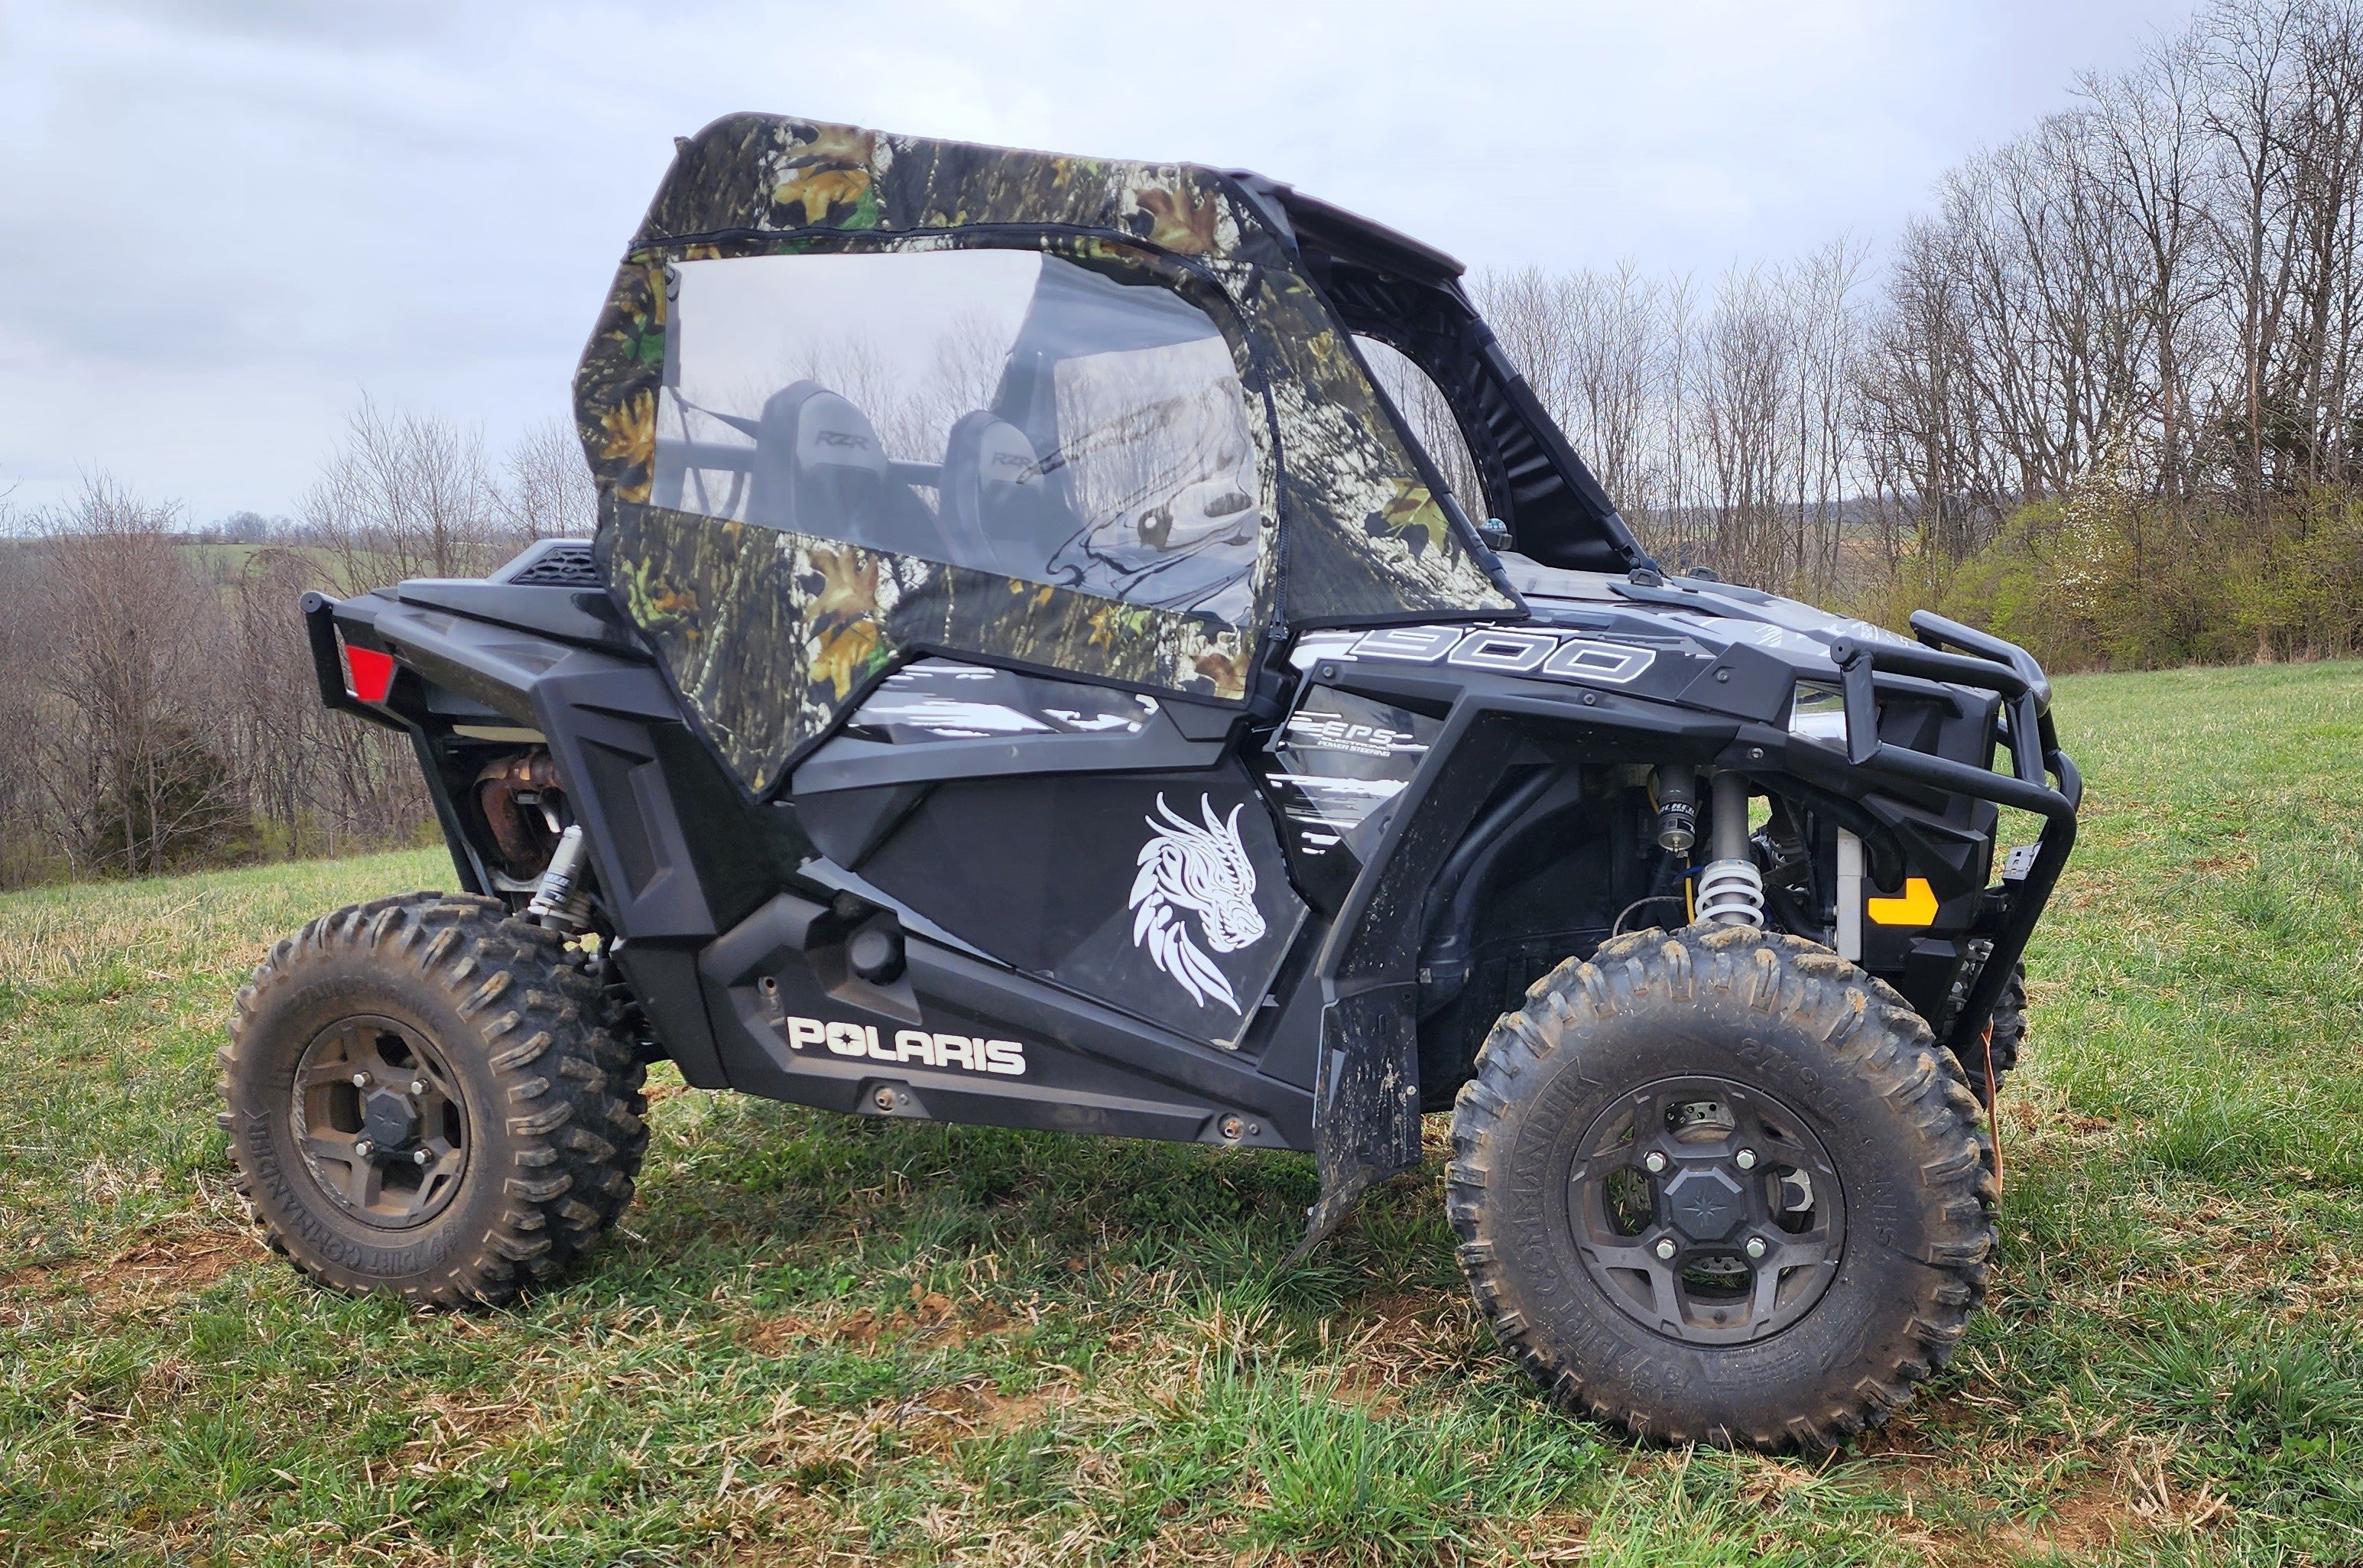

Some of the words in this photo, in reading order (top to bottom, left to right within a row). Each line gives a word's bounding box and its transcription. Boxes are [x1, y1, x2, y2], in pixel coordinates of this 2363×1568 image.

[814, 430, 869, 451] RZR
[1349, 625, 1657, 683] 900
[1322, 720, 1397, 745] EPS
[1317, 740, 1349, 751] POWER
[1349, 745, 1391, 758] STEERING
[787, 1016, 1026, 1076] POLARIS
